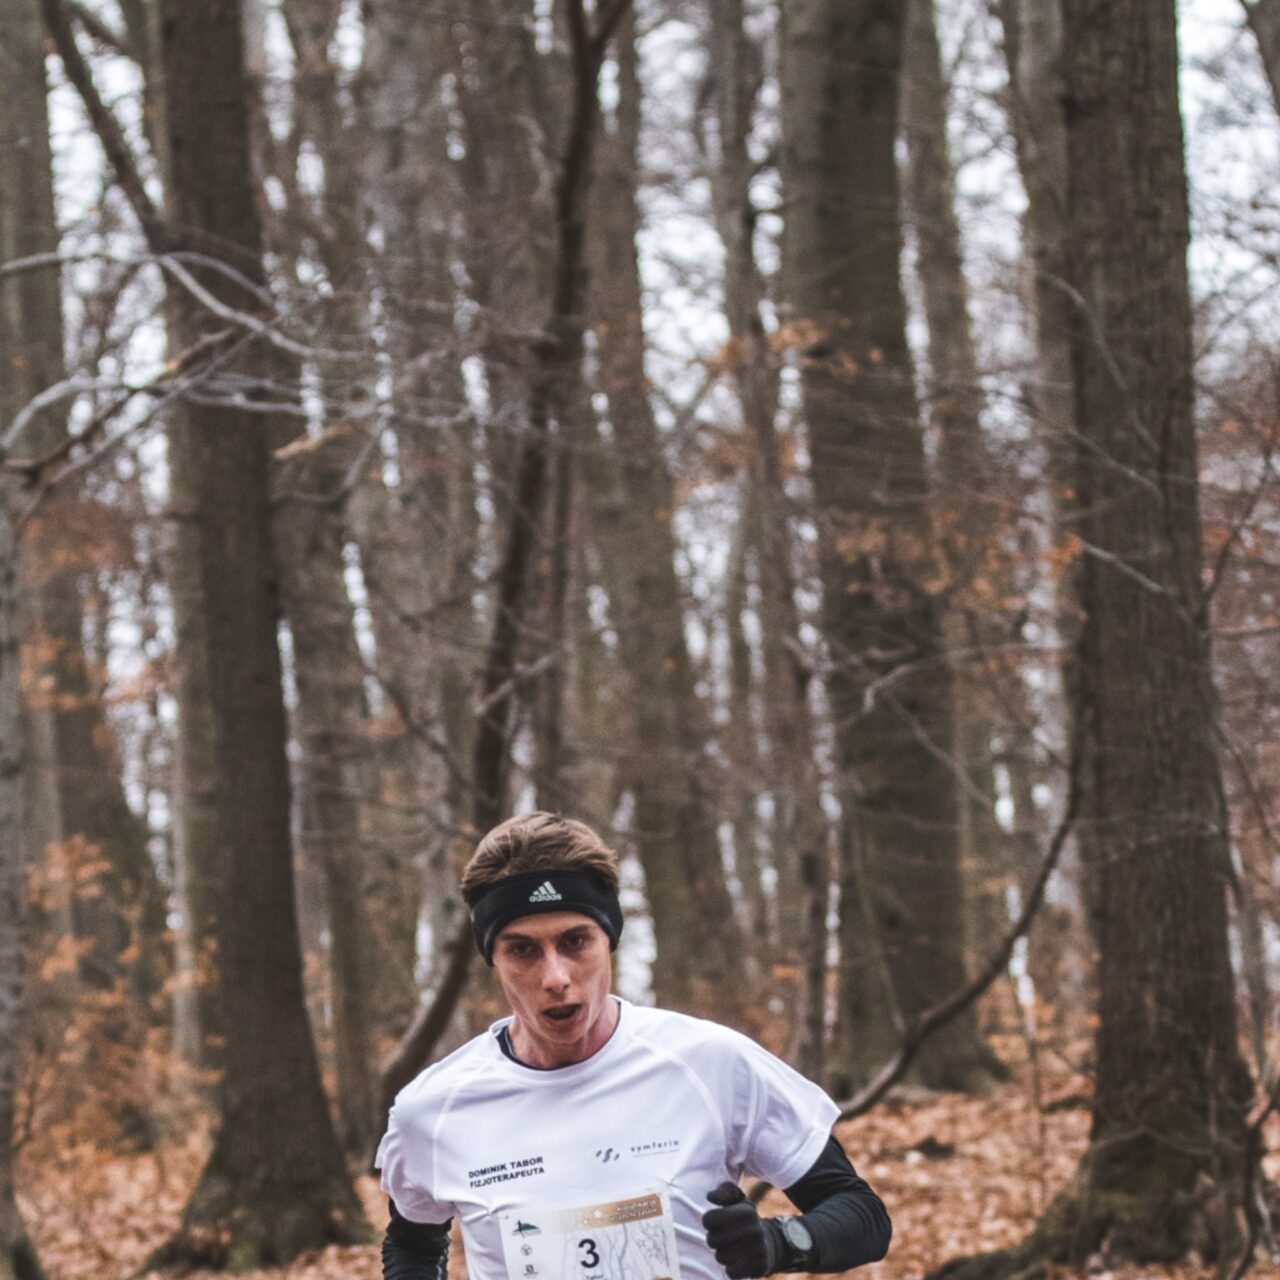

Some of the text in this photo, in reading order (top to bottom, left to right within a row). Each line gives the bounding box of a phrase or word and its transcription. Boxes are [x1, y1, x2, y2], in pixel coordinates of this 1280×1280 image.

[468, 1156, 544, 1179] DOMINIK TABOR
[469, 1166, 545, 1188] FIZJOTERAPEUTA
[578, 1239, 600, 1269] 3
